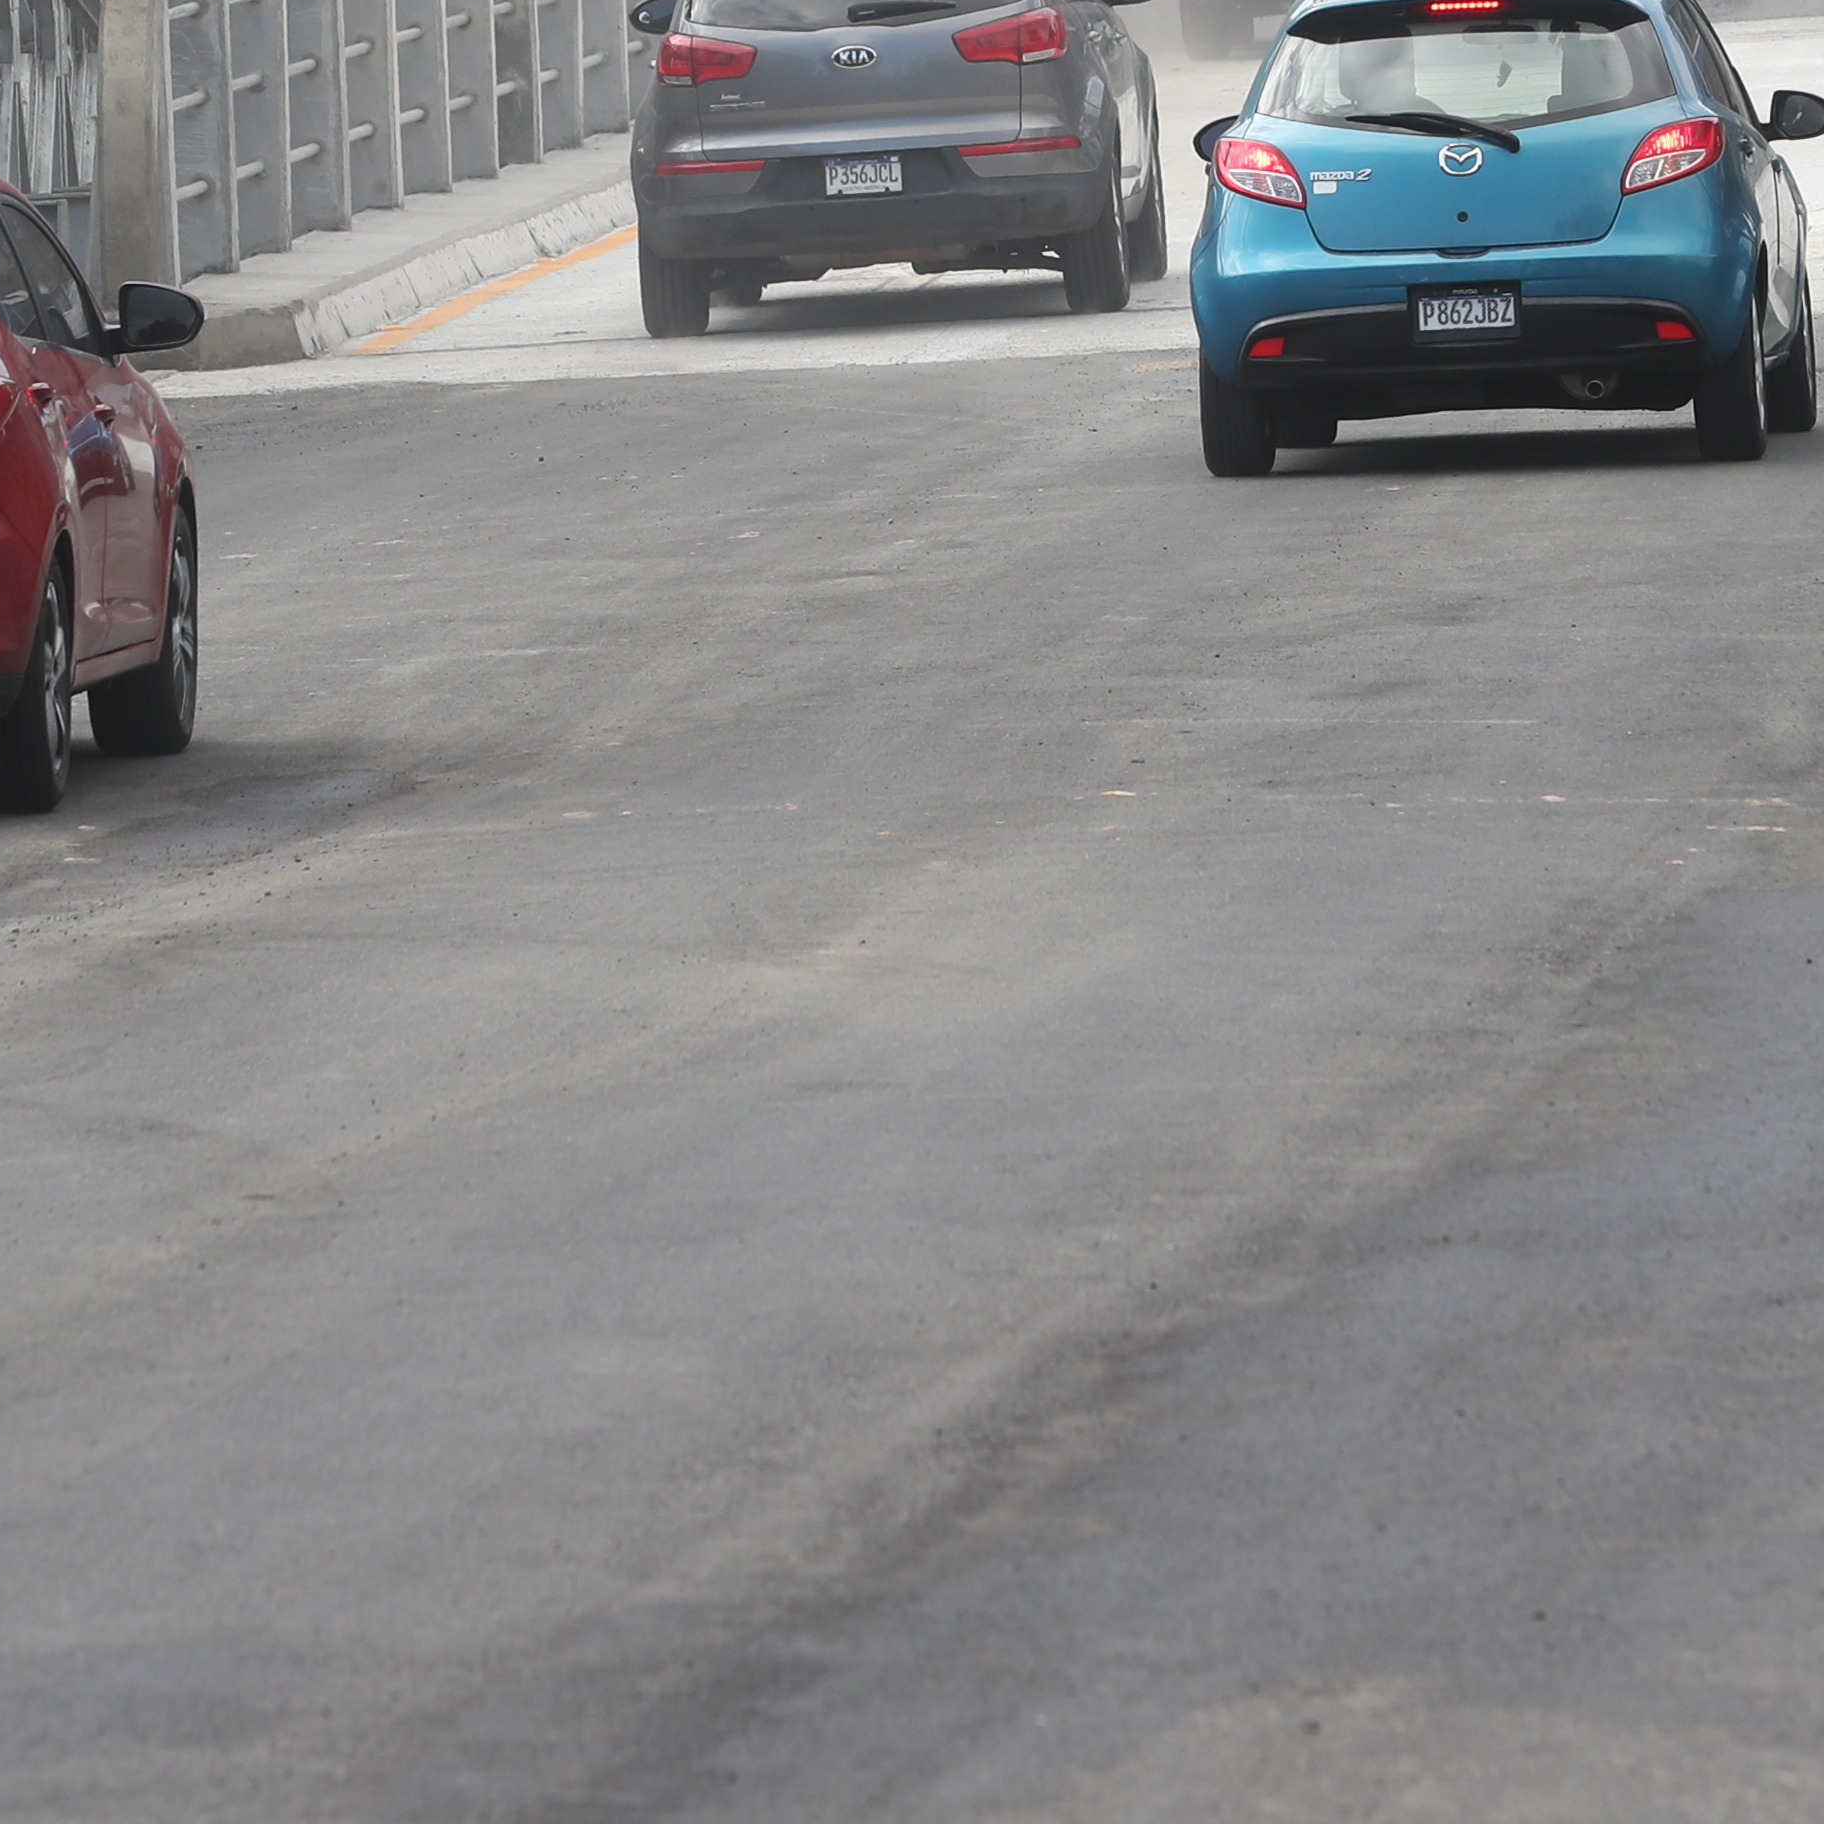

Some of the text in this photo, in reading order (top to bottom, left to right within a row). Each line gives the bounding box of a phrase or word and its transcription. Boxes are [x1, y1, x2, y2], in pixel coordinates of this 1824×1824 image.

[839, 50, 869, 64] KIA
[829, 164, 899, 186] P356JCL
[1356, 168, 1372, 181] 2
[1422, 298, 1513, 327] P862JBZ
